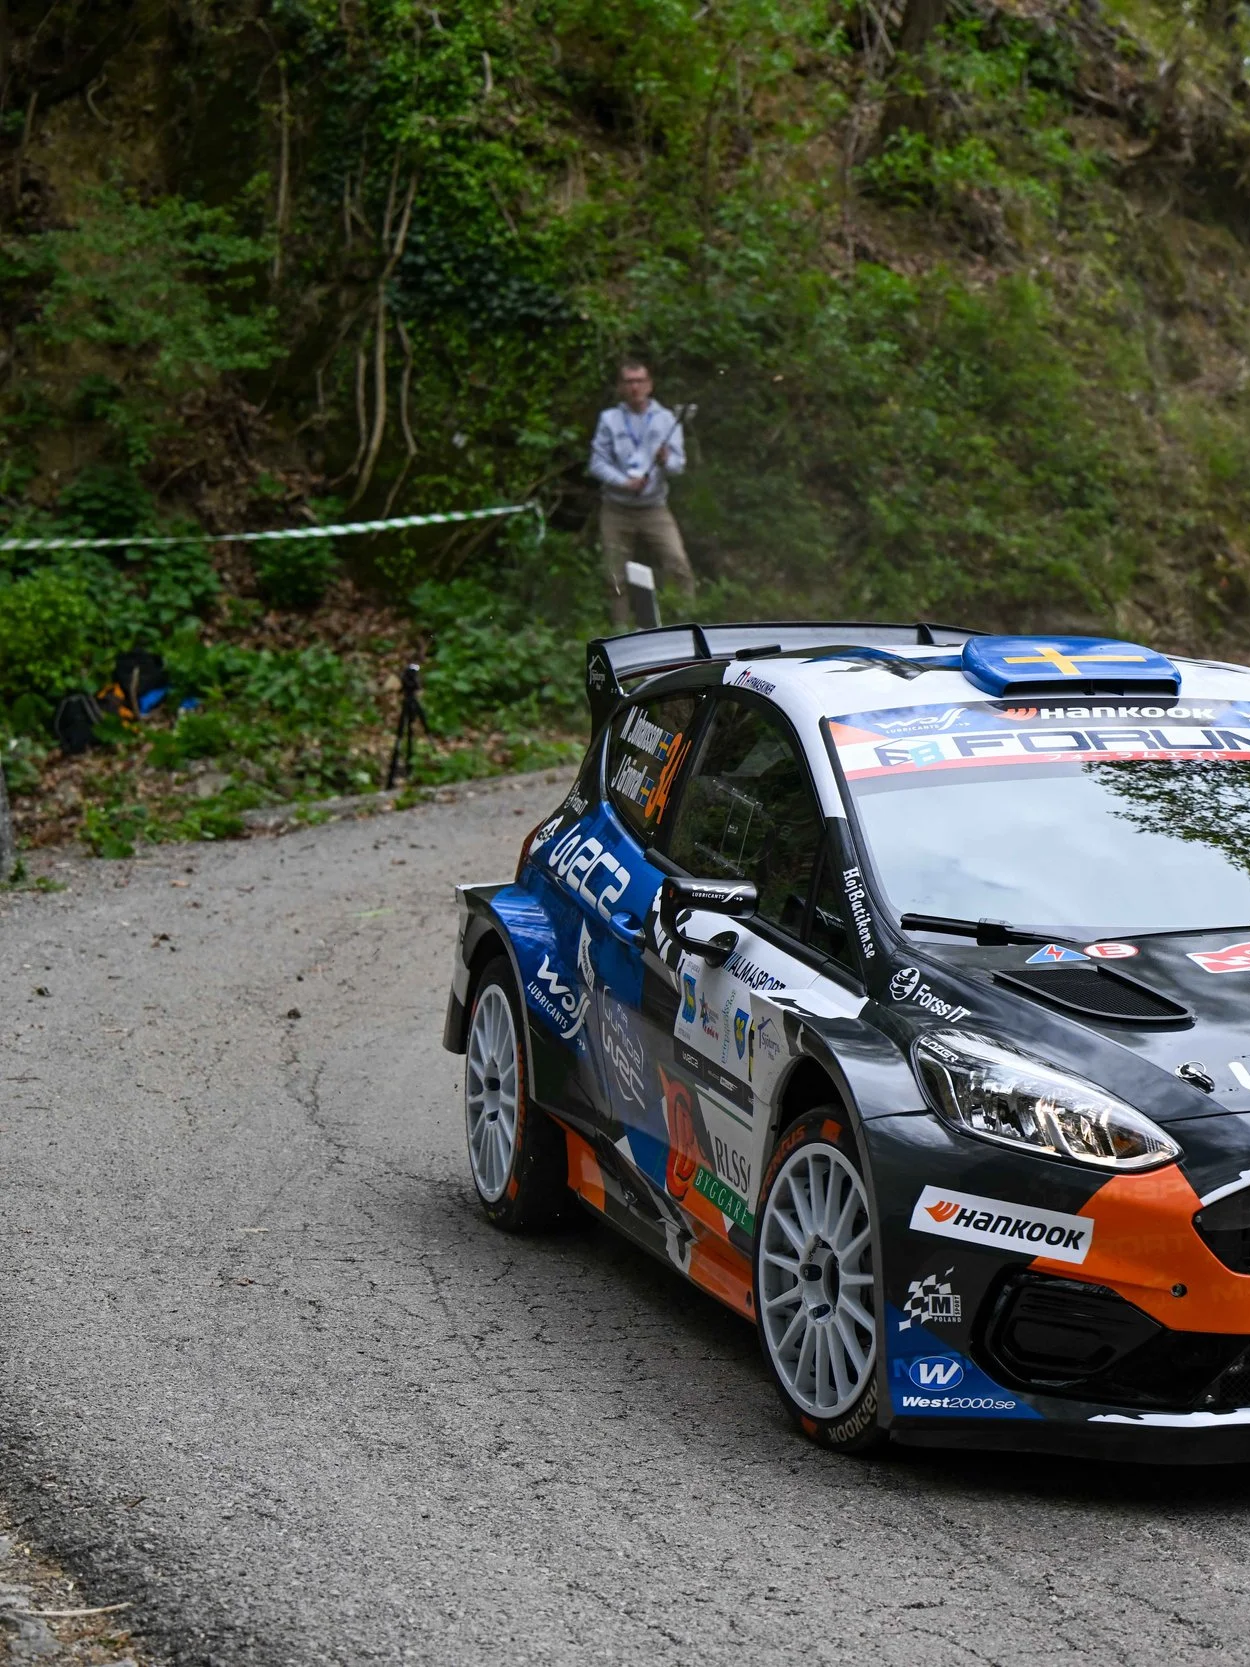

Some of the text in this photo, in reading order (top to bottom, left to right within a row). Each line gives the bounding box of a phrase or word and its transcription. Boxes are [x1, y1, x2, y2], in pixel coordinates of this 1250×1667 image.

[644, 732, 692, 824] 34
[527, 980, 569, 1031] LUBRICANTS
[912, 983, 952, 1018] Forss
[695, 1170, 750, 1226] BYGGARE
[931, 1295, 951, 1315] M
[934, 1315, 962, 1323] POLAND
[919, 1362, 960, 1385] W
[902, 1395, 1016, 1410] West2000.se
